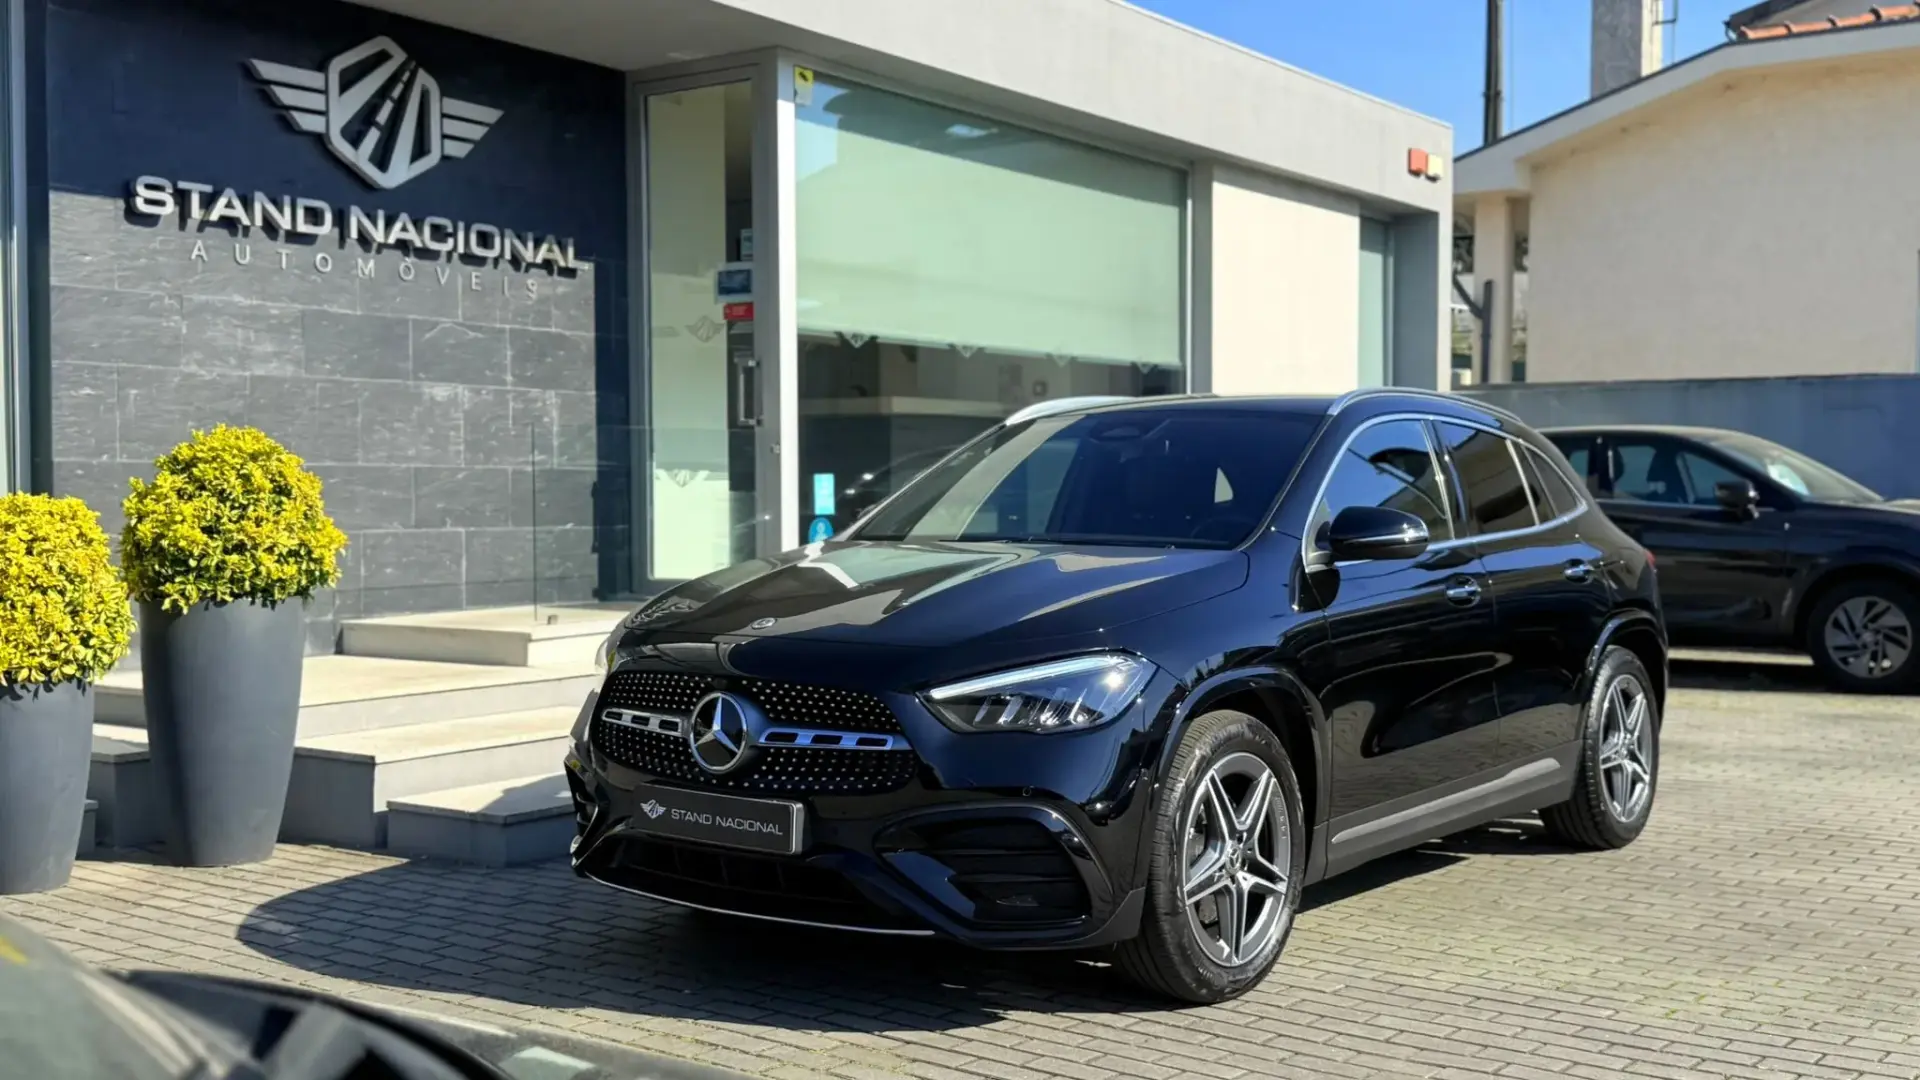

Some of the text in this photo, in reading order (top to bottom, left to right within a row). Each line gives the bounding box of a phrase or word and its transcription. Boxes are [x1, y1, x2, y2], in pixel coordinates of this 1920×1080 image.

[135, 175, 590, 271] STAND NACIONAL
[671, 809, 783, 835] STAND NACIONAL
